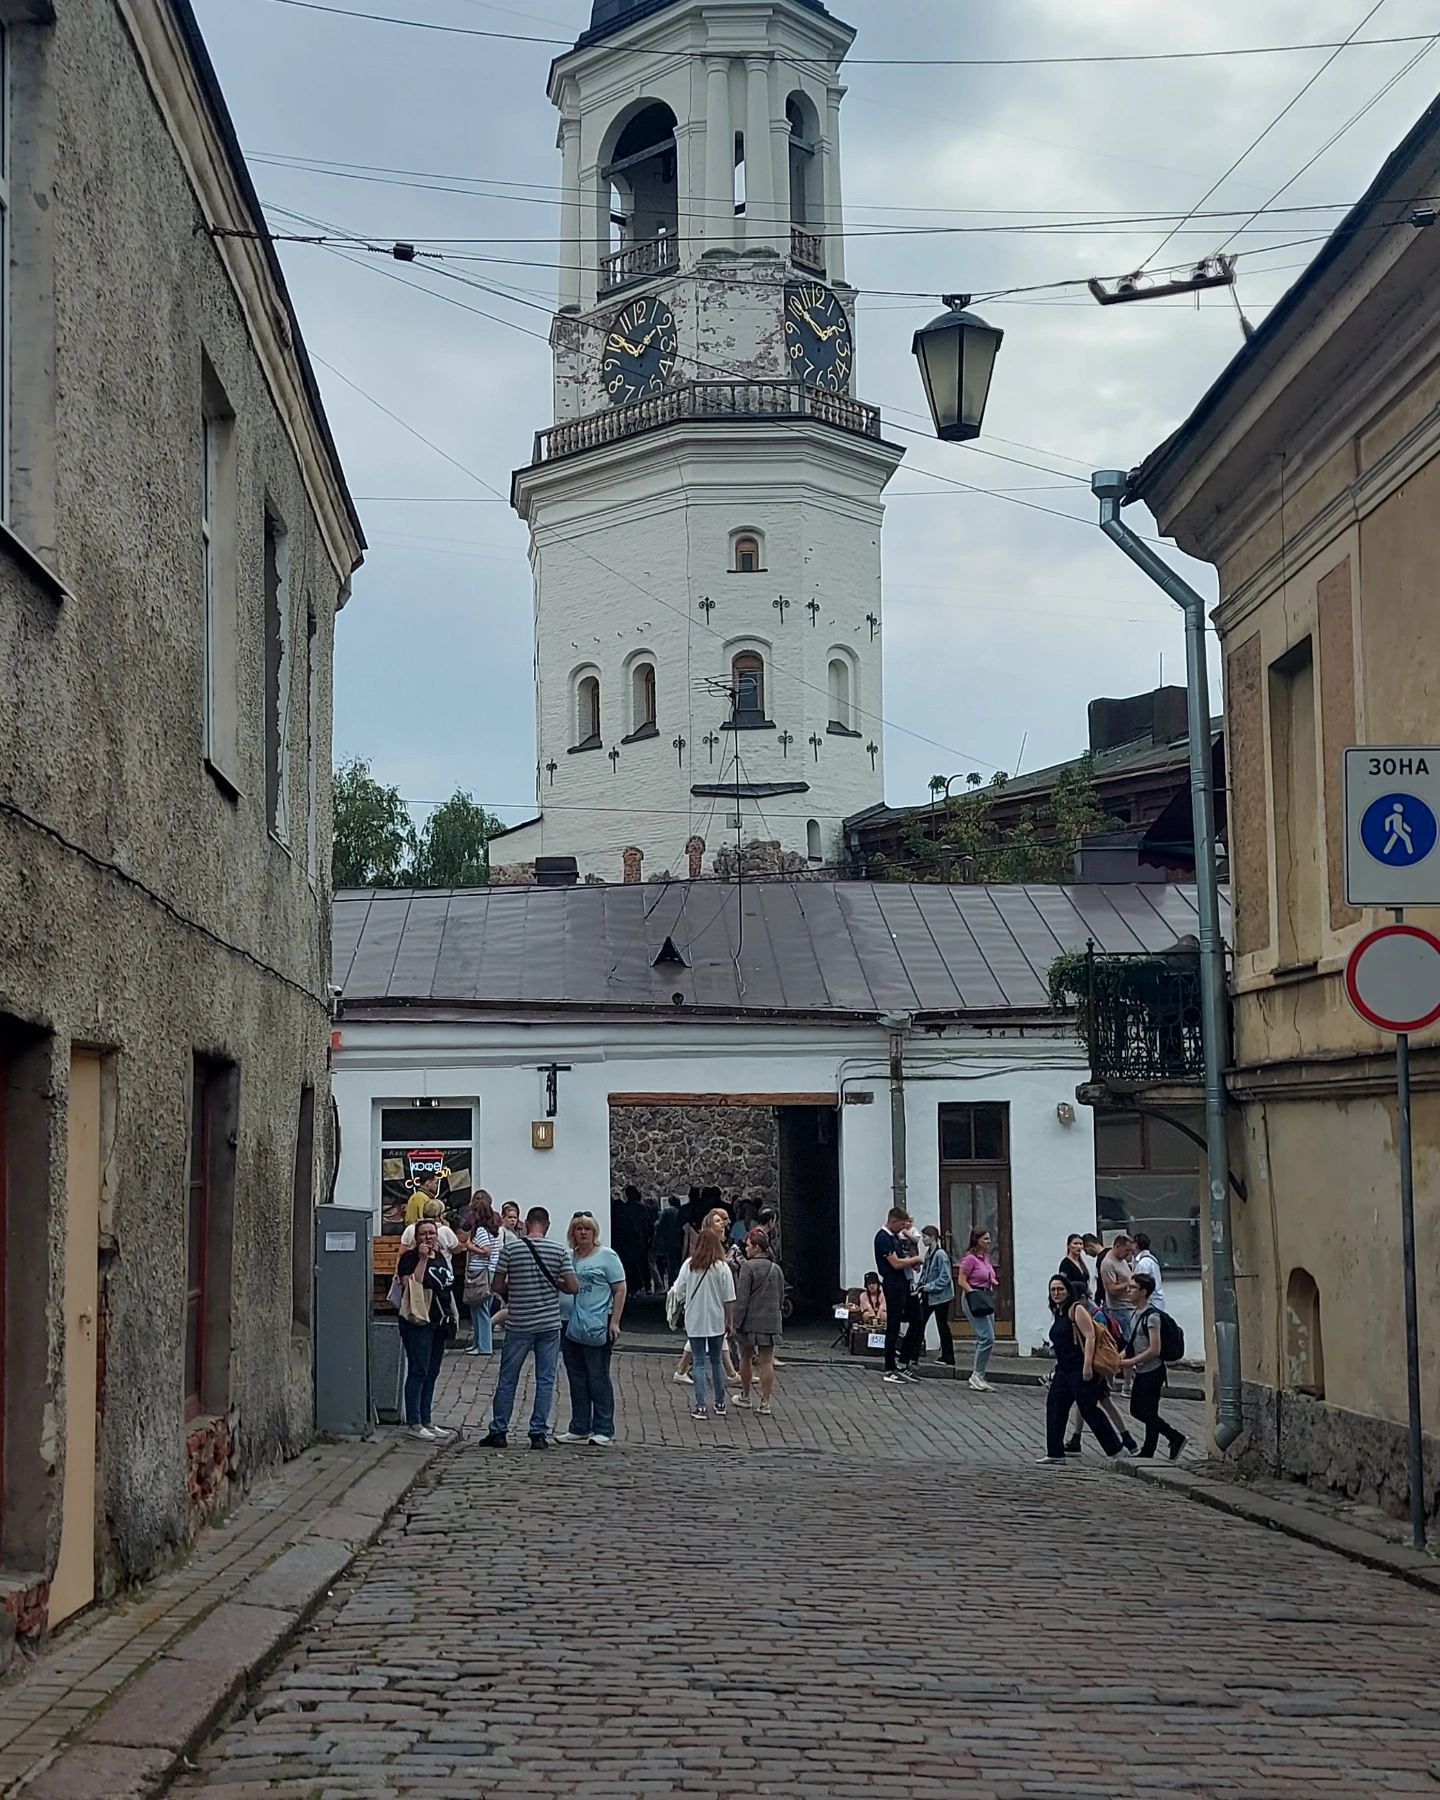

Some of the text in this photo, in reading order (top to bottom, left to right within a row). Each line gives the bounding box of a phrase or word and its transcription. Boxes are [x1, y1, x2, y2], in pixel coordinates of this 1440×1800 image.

[799, 284, 811, 309] 11
[812, 282, 825, 310] 12
[633, 300, 646, 327] 12
[650, 300, 659, 323] 1
[827, 299, 835, 317] 1
[619, 312, 632, 334] 11
[656, 313, 673, 336] 2
[785, 321, 800, 335] 9
[833, 317, 847, 336] 2
[660, 333, 677, 352] 3
[790, 343, 803, 359] 8
[835, 339, 851, 357] 3
[604, 358, 621, 371] 9
[659, 357, 674, 377] 4
[803, 357, 815, 379] 7
[835, 358, 850, 379] 4
[608, 374, 624, 393] 8
[649, 374, 663, 393] 5
[827, 366, 838, 392] 5
[623, 384, 635, 403] 7
[1368, 758, 1430, 776] ЗОНА
